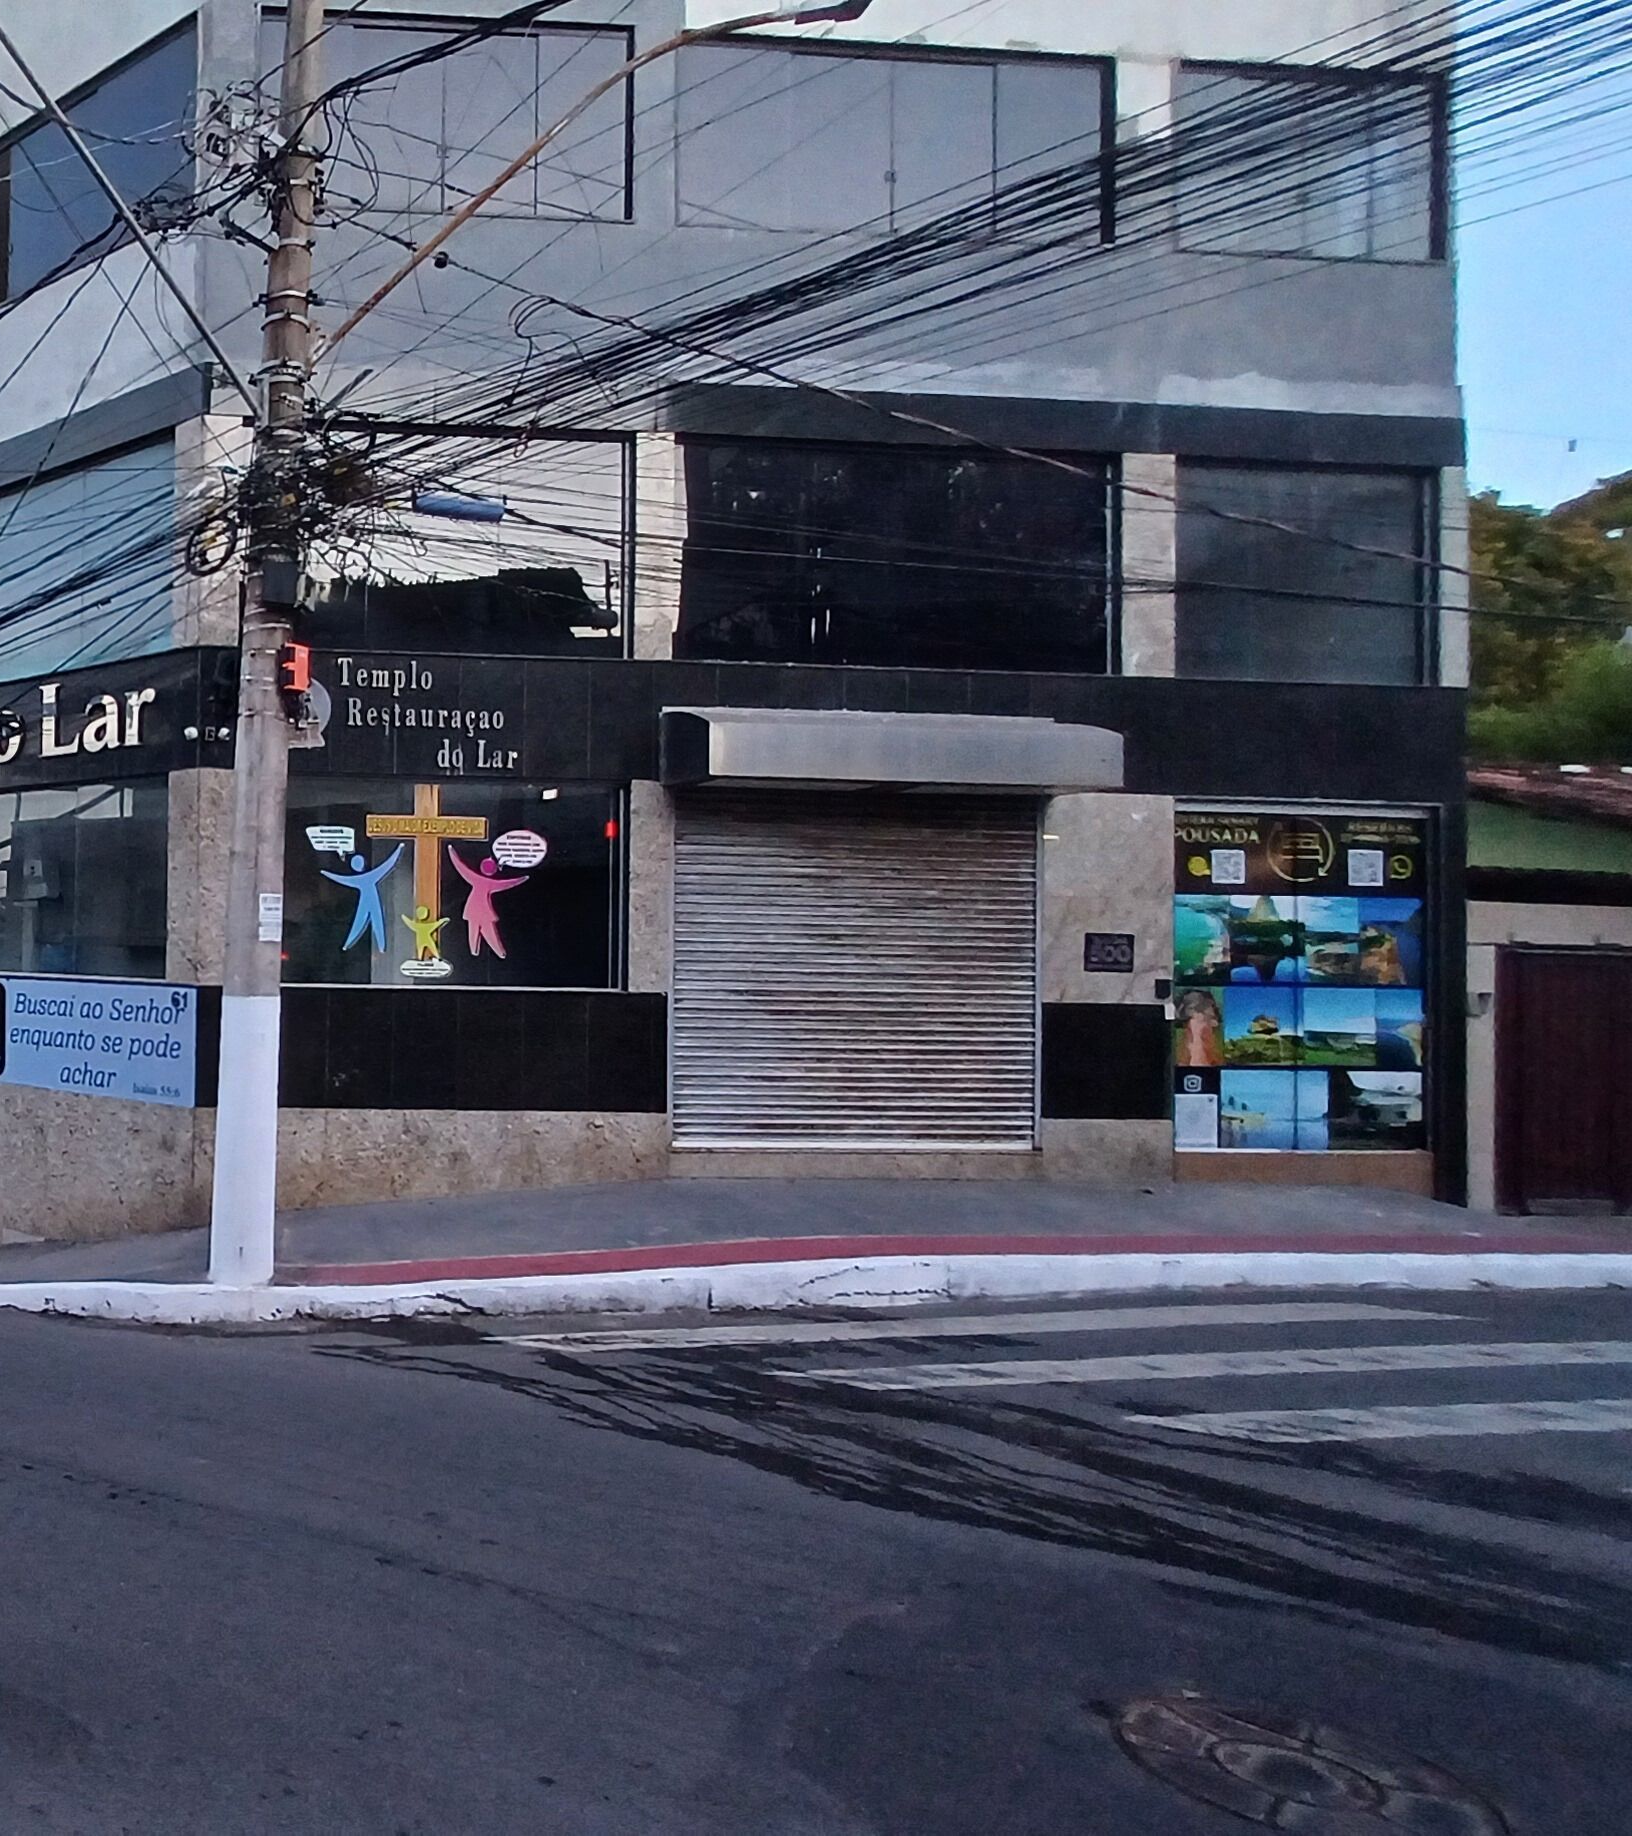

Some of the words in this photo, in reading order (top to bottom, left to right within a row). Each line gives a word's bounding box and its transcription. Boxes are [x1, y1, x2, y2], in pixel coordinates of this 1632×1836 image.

[337, 657, 433, 697] Templo
[39, 683, 156, 758] Lar
[437, 739, 464, 769] do
[477, 740, 519, 769] Lar
[14, 992, 76, 1018] Buscai
[79, 1001, 104, 1020] ao
[109, 998, 185, 1025] Senhor
[10, 1026, 96, 1052] enquanto
[101, 1035, 123, 1054] se
[127, 1033, 182, 1061] pode
[60, 1061, 117, 1088] achar
